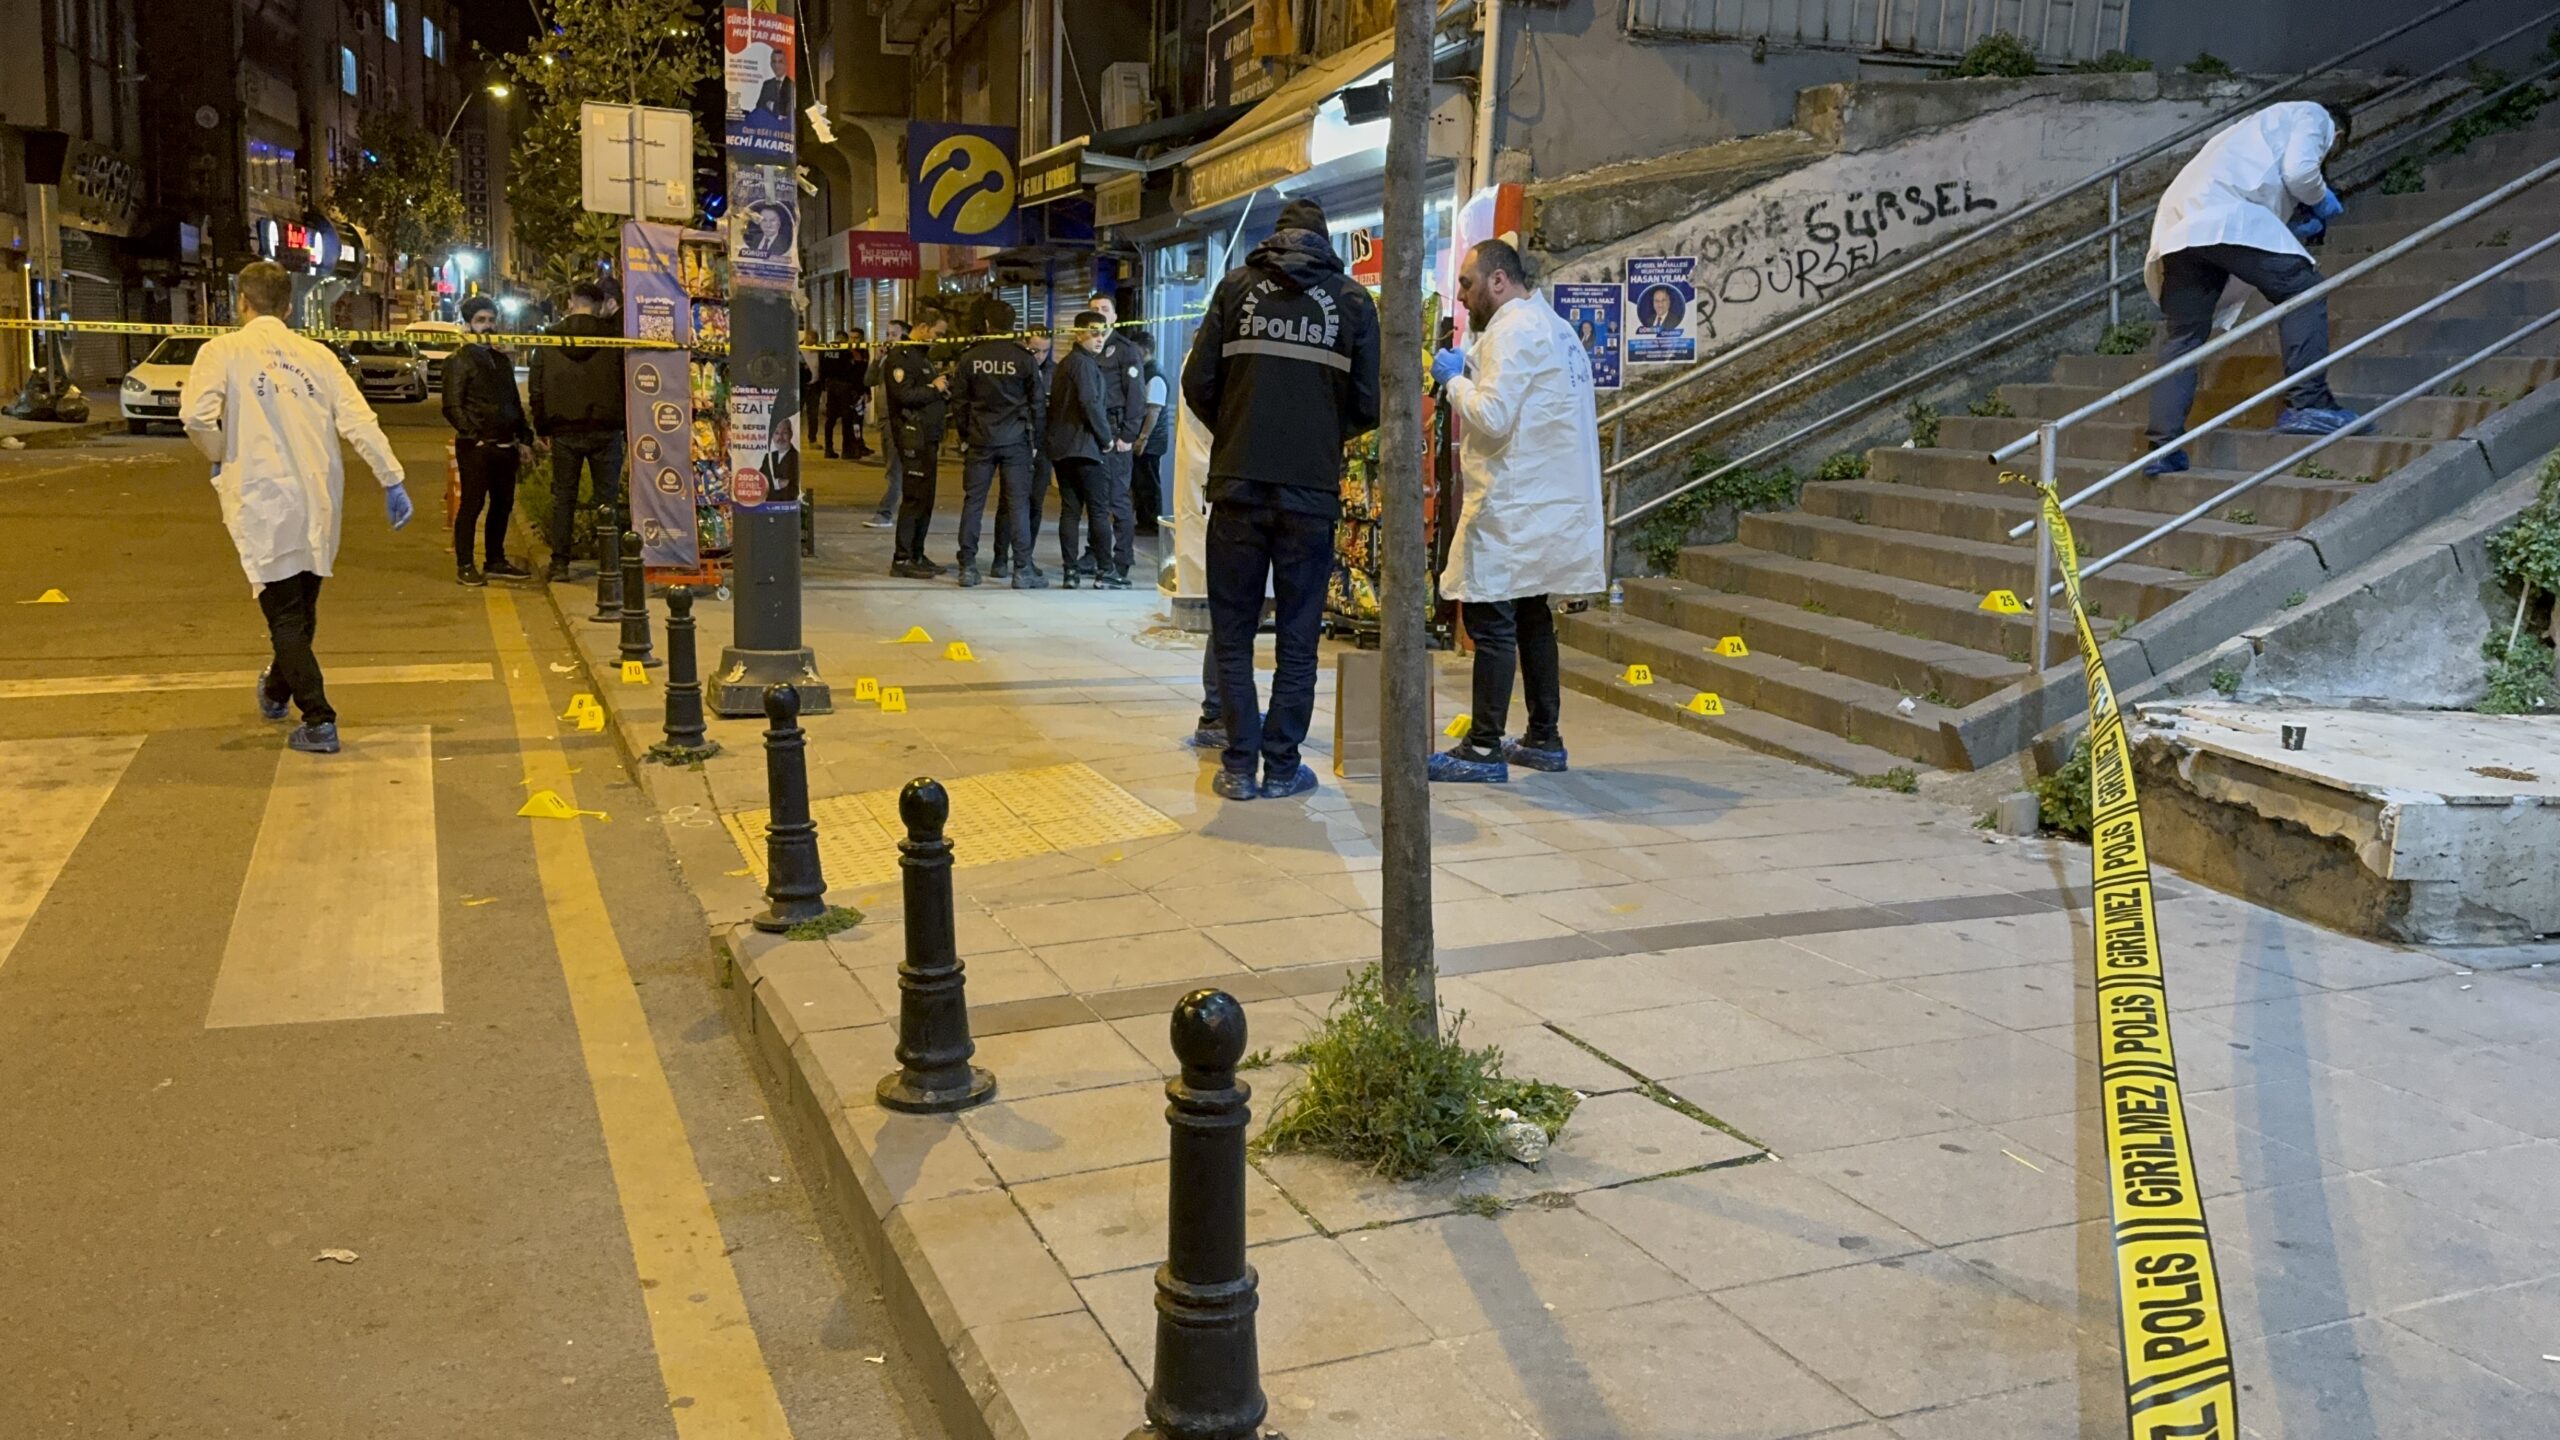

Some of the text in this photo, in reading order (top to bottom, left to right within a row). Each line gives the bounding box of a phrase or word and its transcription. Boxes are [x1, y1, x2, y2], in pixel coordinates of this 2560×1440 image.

[754, 138, 794, 154] AKARSU
[1630, 275, 1659, 284] HASAN
[1560, 297, 1615, 305] HASAN YILMAZ
[1240, 291, 1259, 336] OLAY
[1252, 316, 1322, 344] POLİS
[973, 359, 1017, 376] POLİS
[738, 474, 760, 482] 2024
[2000, 595, 2015, 607] 25
[1730, 642, 1743, 653] 24
[628, 666, 641, 676] 10
[1635, 669, 1648, 680] 23
[888, 692, 900, 702] 17
[1704, 699, 1718, 711] 22
[588, 711, 596, 721] 9
[2096, 730, 2128, 808] GİRİLMEZ
[2102, 820, 2139, 872] POLİS
[2103, 887, 2149, 969] GİRİLMEZ
[2110, 994, 2163, 1055] POLİS
[2116, 1085, 2184, 1208] GİRİLMEZ
[2135, 1252, 2210, 1363] POLİS
